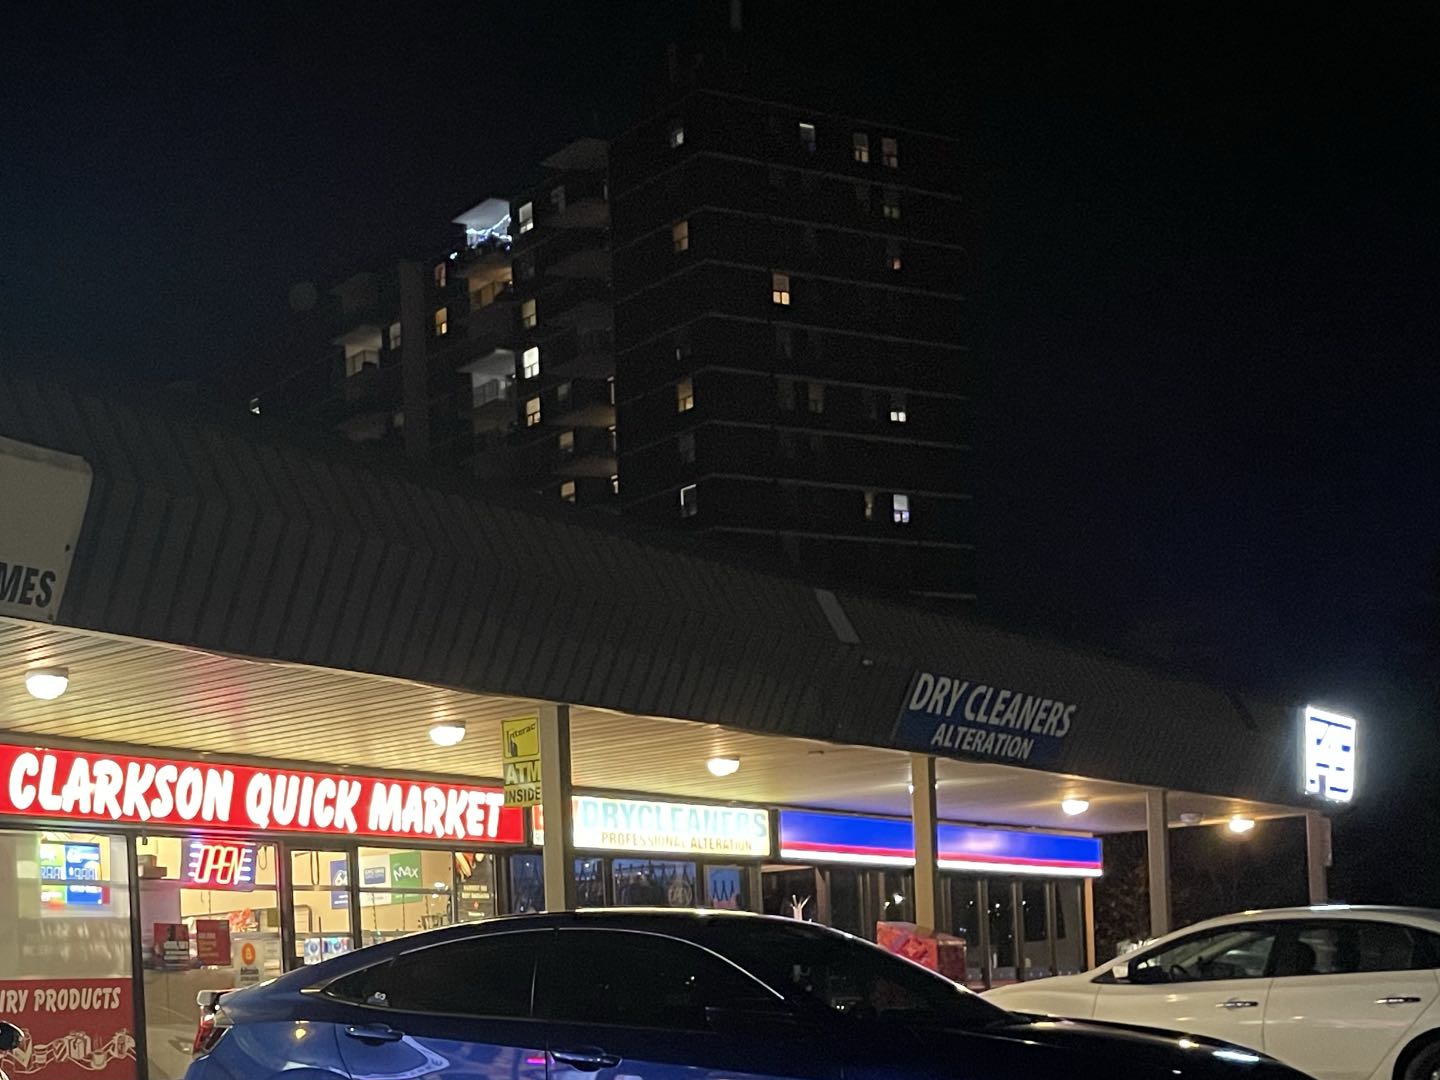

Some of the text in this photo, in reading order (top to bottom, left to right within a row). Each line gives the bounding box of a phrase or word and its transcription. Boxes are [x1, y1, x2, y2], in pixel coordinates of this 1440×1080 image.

[909, 673, 1077, 737] DRY CLEANERS
[930, 723, 1035, 760] ALTERATION
[505, 763, 540, 785] ATM
[9, 752, 235, 822] CLARKSON
[245, 771, 361, 833] QUICK
[367, 781, 504, 839] MARKET
[504, 787, 540, 804] INSIDE
[582, 801, 768, 837] DRYCLEANERS
[690, 837, 752, 851] ALTERATION
[194, 845, 246, 885] OPEN
[34, 986, 121, 1013] PRODUCTS
